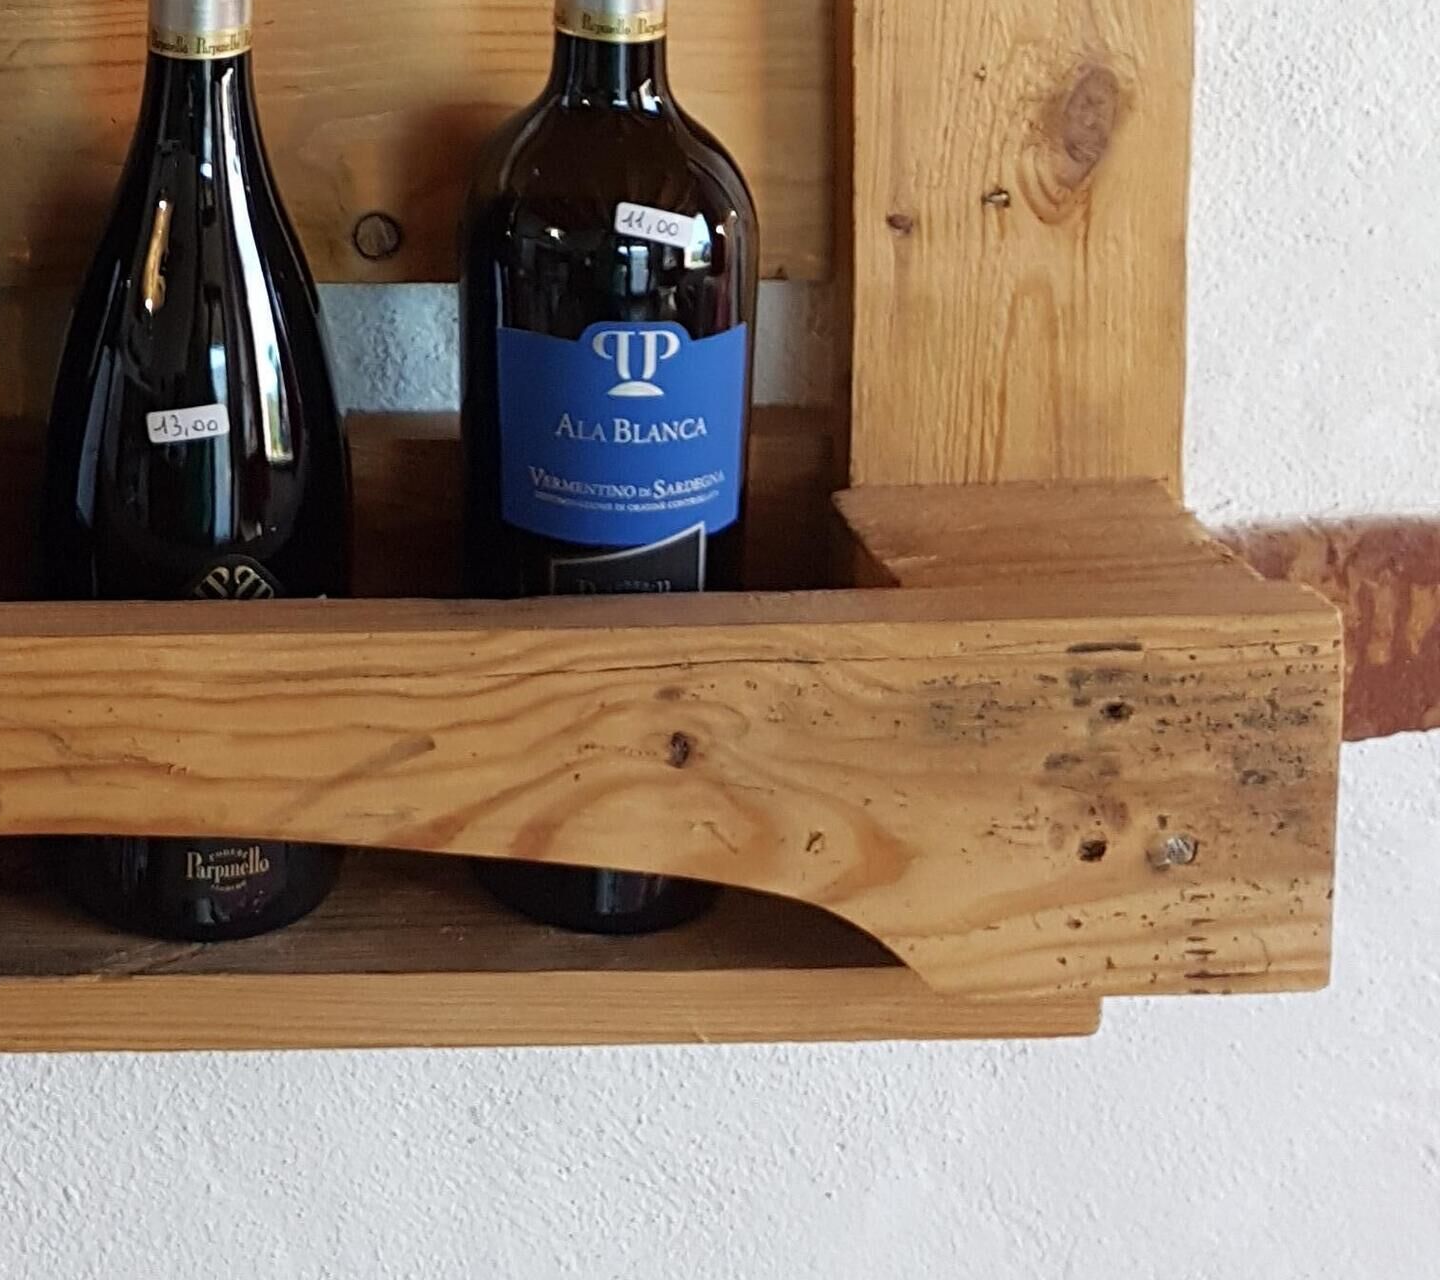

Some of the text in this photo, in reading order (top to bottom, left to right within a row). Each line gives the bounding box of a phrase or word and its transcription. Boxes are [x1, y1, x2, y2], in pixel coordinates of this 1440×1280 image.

[620, 210, 679, 237] 11,00
[153, 413, 218, 438] 13,00
[555, 413, 708, 443] ALA BLANCA
[186, 845, 270, 884] Parpinello
